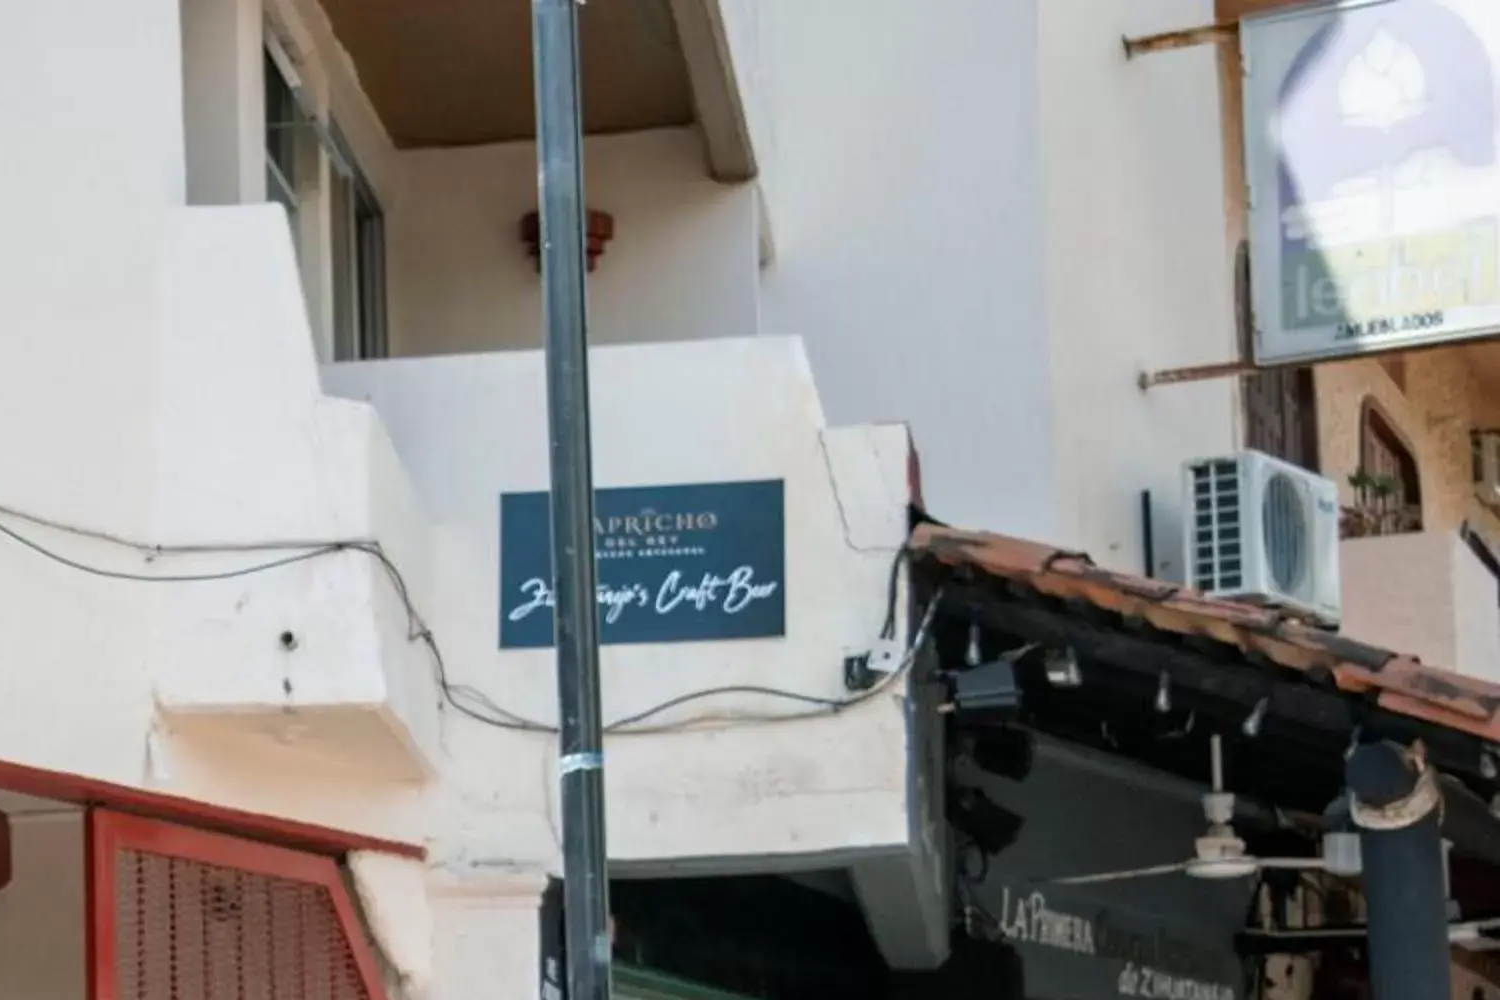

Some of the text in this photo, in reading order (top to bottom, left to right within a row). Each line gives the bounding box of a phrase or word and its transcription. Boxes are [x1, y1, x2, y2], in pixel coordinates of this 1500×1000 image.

[591, 510, 718, 536] APRICHO
[655, 570, 726, 614] Craft
[722, 565, 778, 614] Beer
